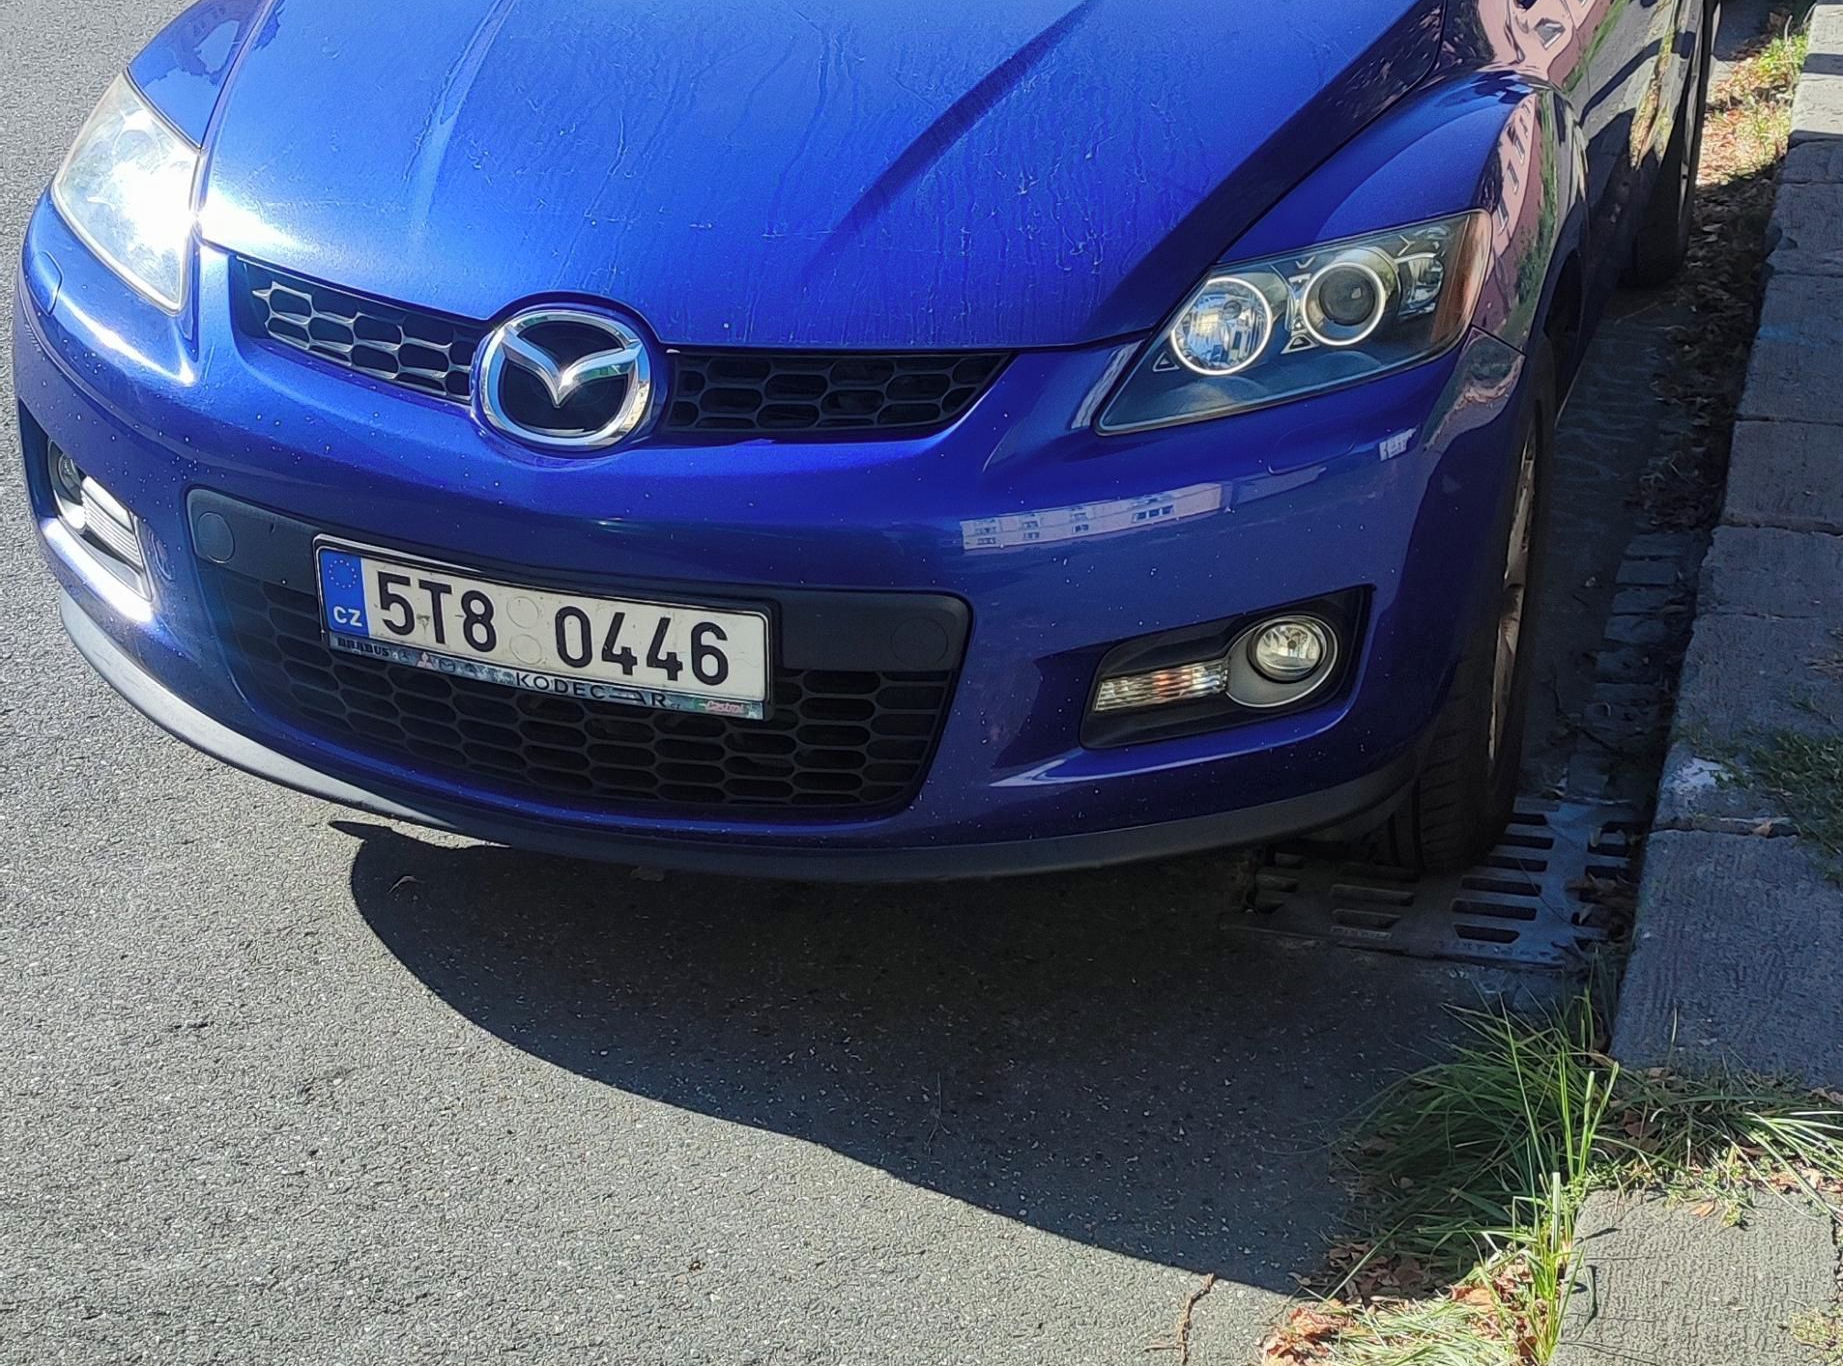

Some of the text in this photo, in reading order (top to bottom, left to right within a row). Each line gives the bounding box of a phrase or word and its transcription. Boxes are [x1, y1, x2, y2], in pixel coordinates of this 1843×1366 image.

[333, 604, 363, 628] CZ
[377, 570, 729, 686] 5T8 0446
[336, 636, 391, 657] BRABUS
[704, 699, 745, 714] Castrol
